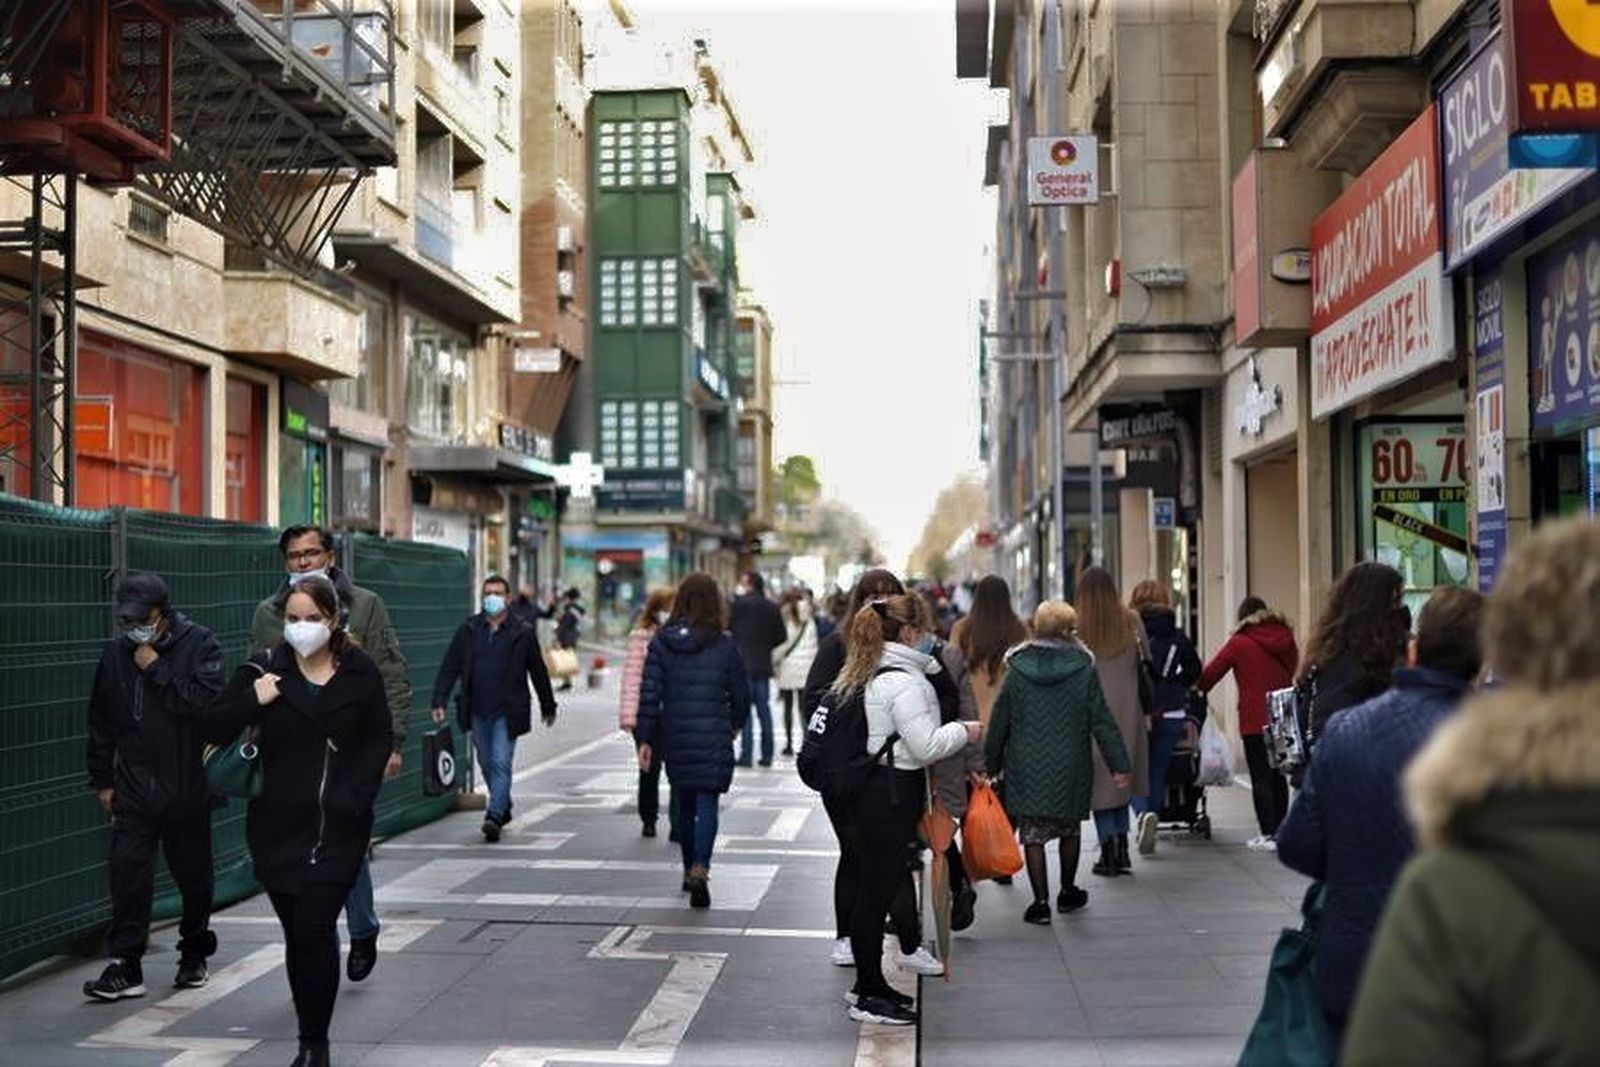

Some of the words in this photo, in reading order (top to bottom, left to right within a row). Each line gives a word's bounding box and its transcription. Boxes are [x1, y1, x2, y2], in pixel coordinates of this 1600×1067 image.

[1446, 52, 1506, 166] SIGLO
[1529, 81, 1597, 111] TAB
[1037, 170, 1092, 185] General
[1384, 156, 1435, 266] TOTAL
